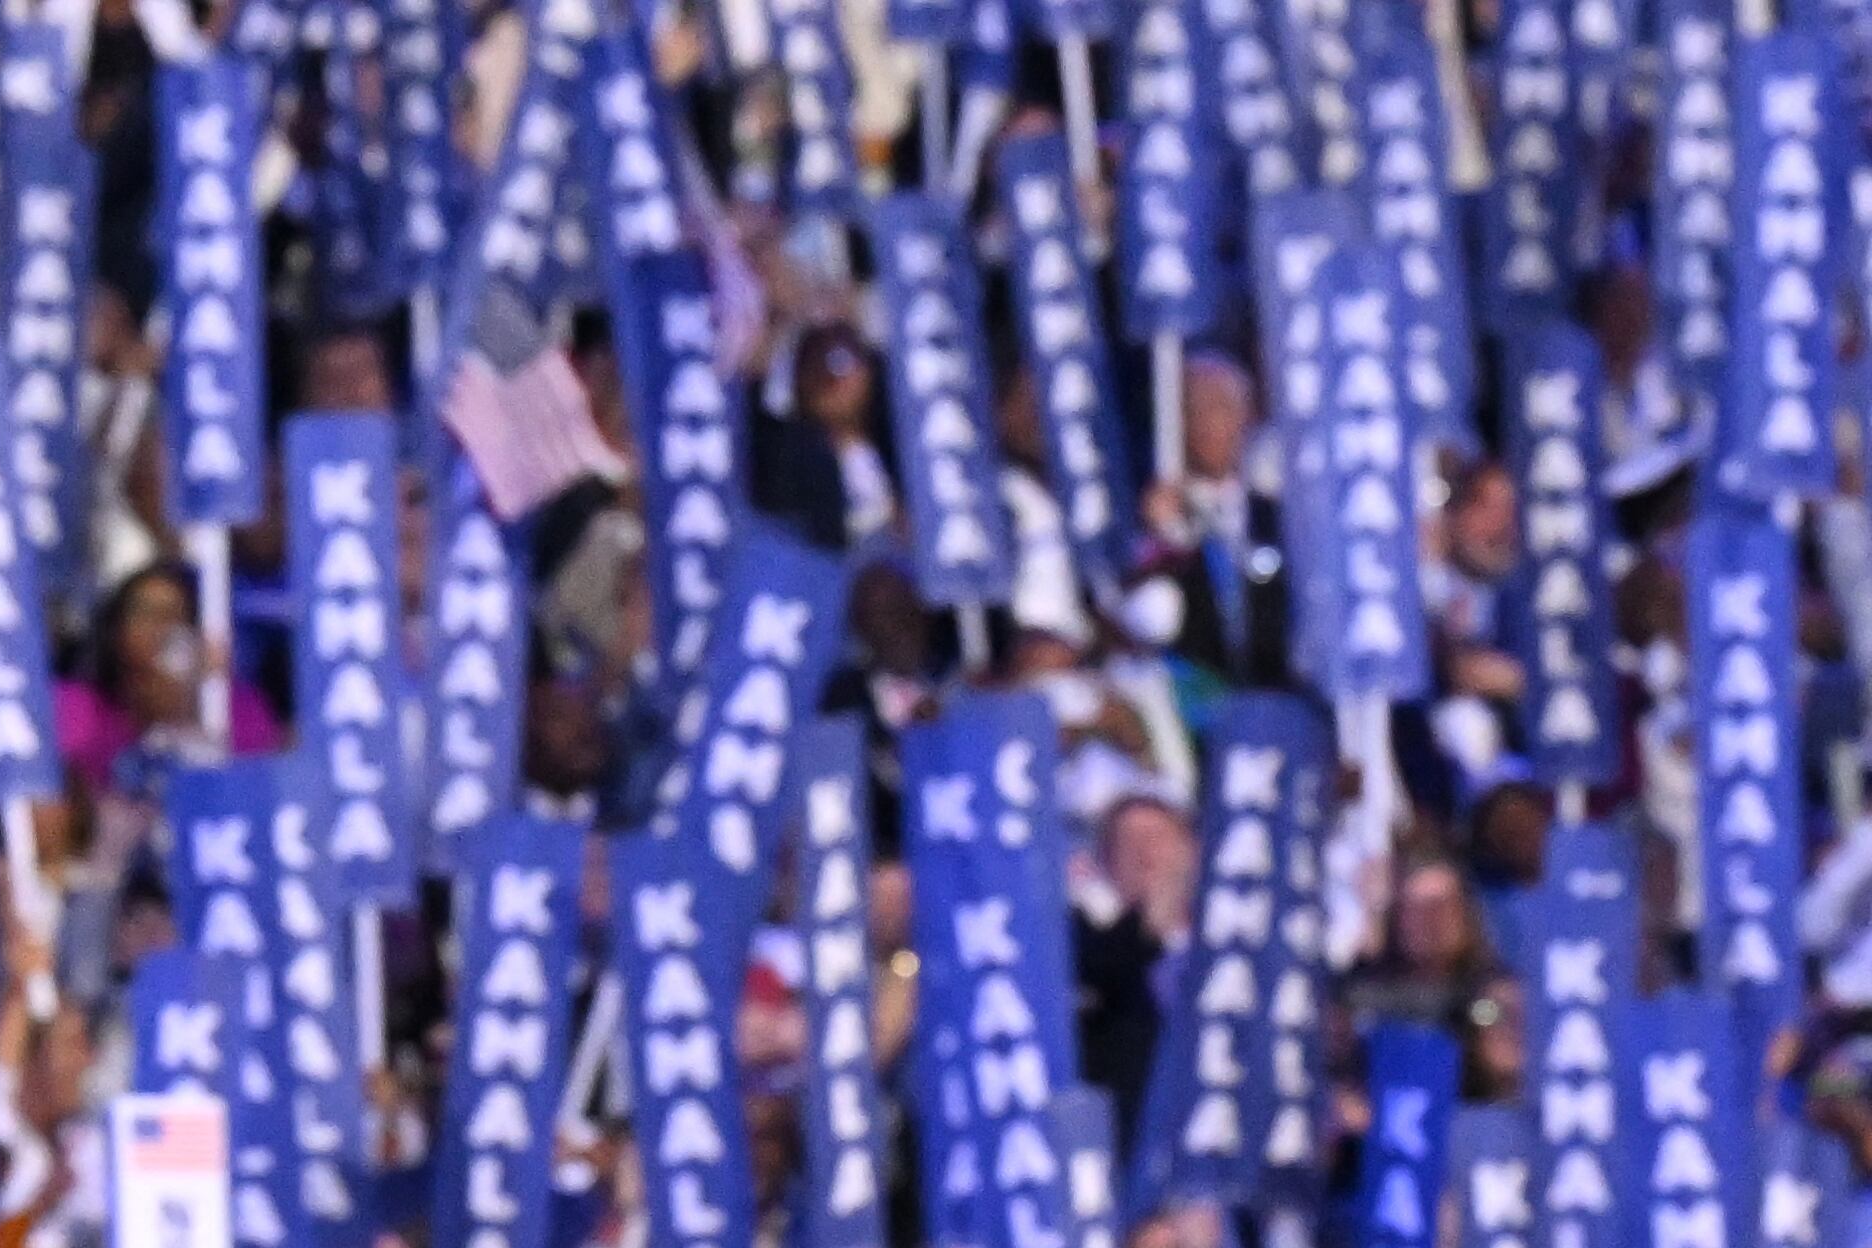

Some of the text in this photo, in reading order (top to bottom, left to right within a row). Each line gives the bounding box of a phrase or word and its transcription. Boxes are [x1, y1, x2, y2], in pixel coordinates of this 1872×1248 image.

[8, 187, 73, 547] KAMALA
[177, 104, 242, 481] KAMALA
[1014, 174, 1110, 541] KAMALA
[1668, 13, 1734, 359] KAMALA
[1754, 73, 1826, 456] KAMALA
[895, 232, 991, 569] KAMALA
[1331, 290, 1404, 656] KAMALA
[1523, 368, 1599, 746] KAMALA
[309, 459, 394, 864] KAMALA
[1710, 571, 1782, 984] KAMALA
[807, 776, 878, 1219] KAMALA
[1183, 743, 1286, 1157] KAMALA
